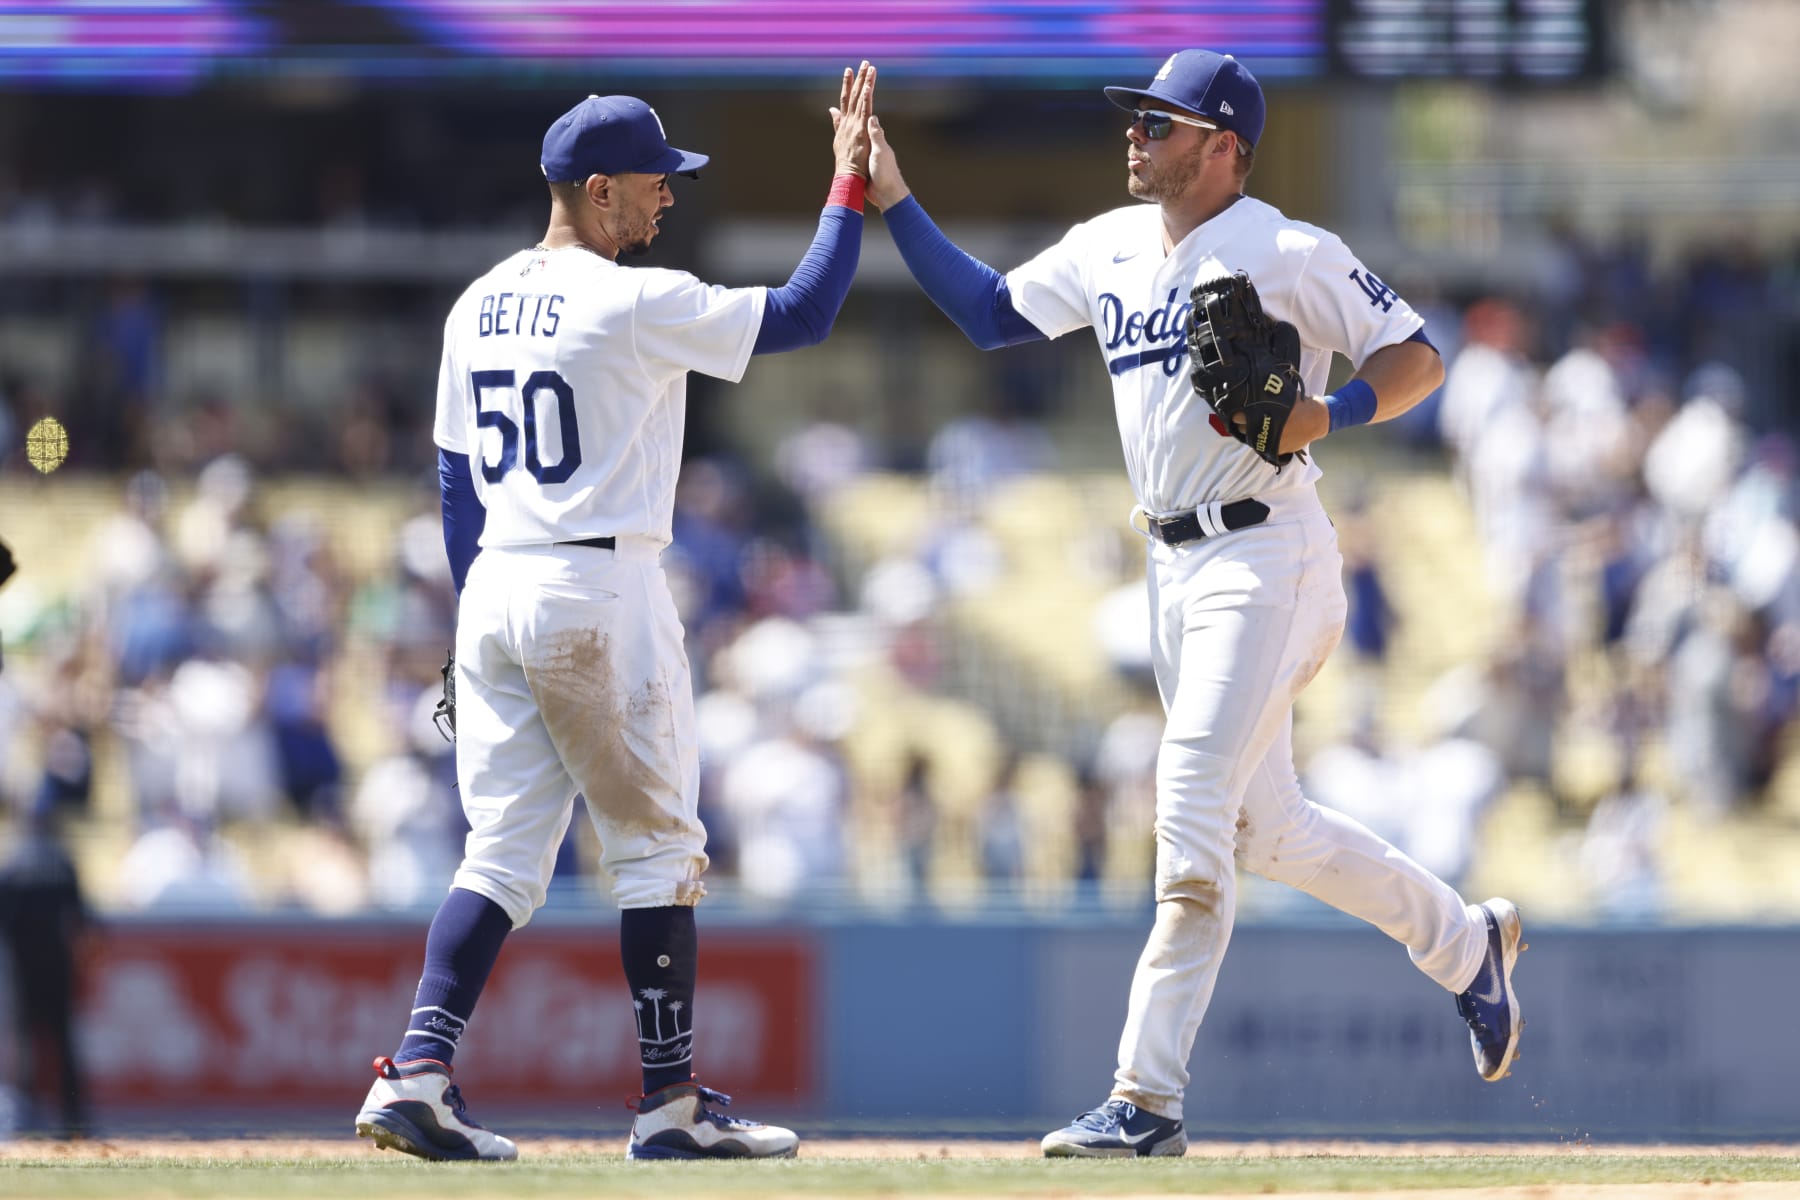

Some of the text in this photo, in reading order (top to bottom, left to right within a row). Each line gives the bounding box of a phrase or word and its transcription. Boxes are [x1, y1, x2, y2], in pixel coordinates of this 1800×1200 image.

[479, 292, 564, 337] BETTS
[1098, 286, 1193, 377] Dodg
[471, 369, 582, 484] 50
[1255, 414, 1272, 453] Wilson
